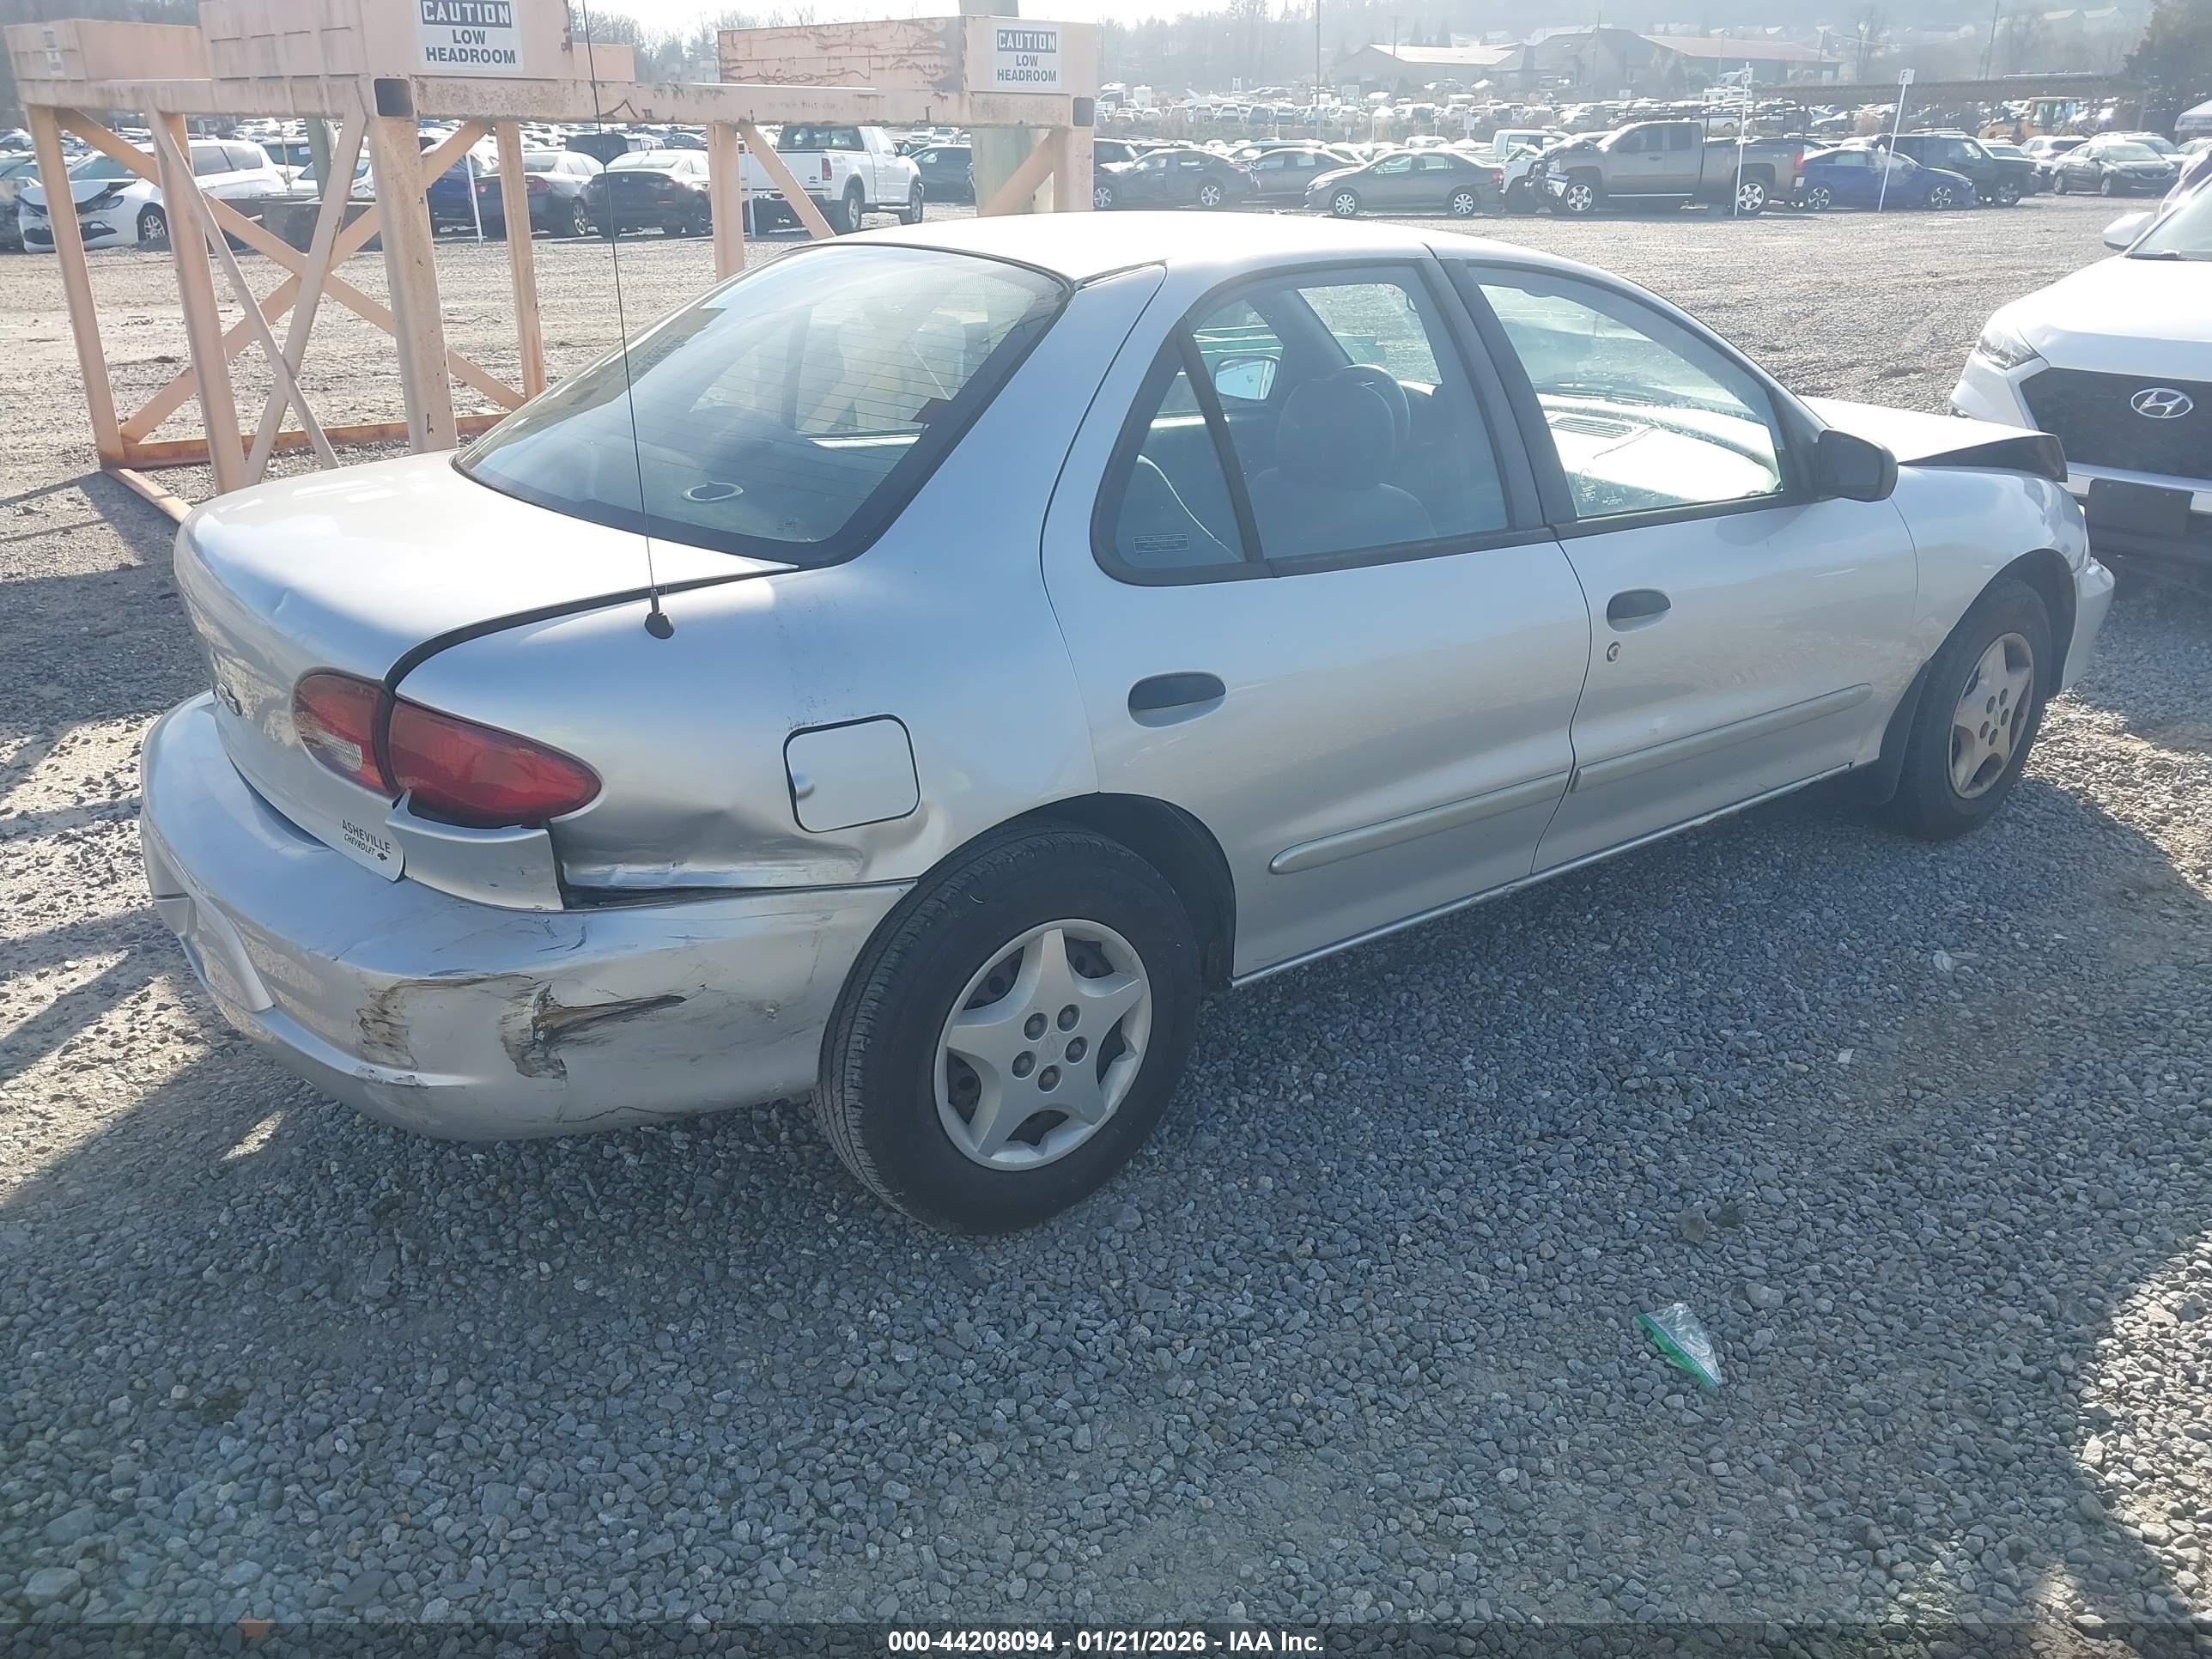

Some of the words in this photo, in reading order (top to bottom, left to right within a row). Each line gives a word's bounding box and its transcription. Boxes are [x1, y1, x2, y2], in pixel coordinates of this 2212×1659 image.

[422, 1, 510, 24] CAUTION
[452, 28, 486, 45] LOW
[998, 32, 1055, 51] CAUTION
[425, 46, 516, 64] HEADROOM
[1016, 54, 1039, 67] LOW
[997, 69, 1057, 82] HEADROOM
[342, 818, 392, 854] ASHEVILLE
[343, 833, 376, 856] CHEVROLET
